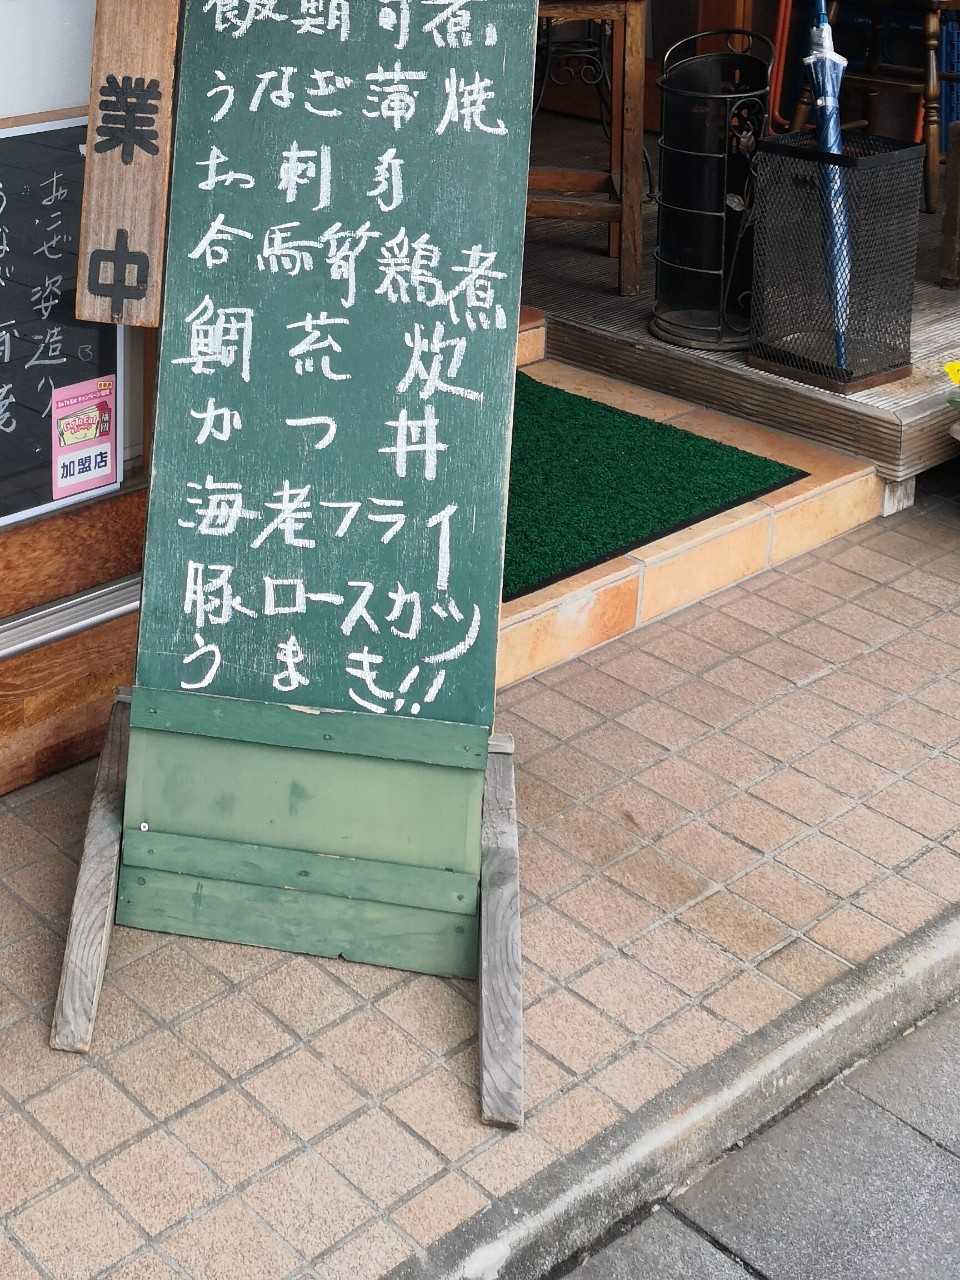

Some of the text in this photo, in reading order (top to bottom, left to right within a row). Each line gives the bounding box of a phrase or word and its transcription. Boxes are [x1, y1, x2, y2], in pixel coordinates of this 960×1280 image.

[205, 60, 509, 137] うなぎ蒲焼
[60, 451, 109, 480] 加盟店
[190, 398, 449, 480] かつ丼
[178, 475, 458, 592] 海老フライ
[183, 560, 481, 664] 豚ロースカツ
